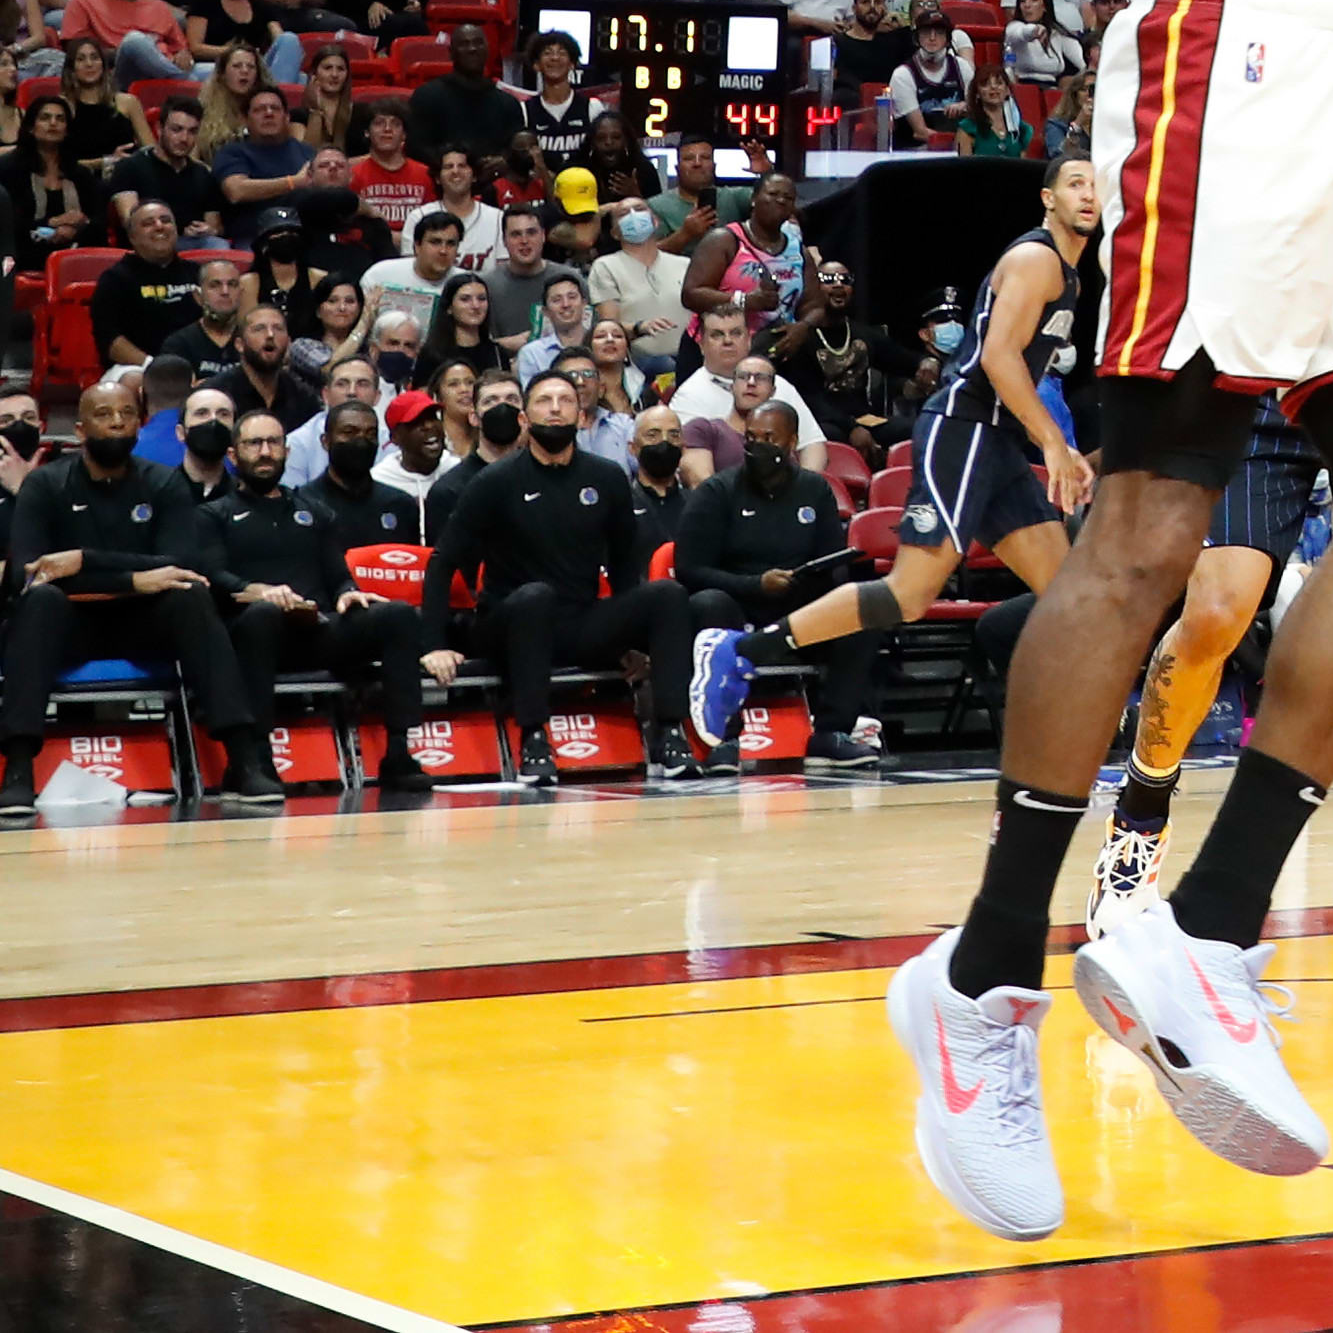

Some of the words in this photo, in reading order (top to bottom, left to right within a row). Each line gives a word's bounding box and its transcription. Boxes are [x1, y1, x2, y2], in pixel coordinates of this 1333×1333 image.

[718, 73, 764, 91] MAGIC
[645, 98, 668, 138] 2
[726, 104, 778, 136] 44
[549, 714, 596, 734] BIO
[70, 736, 123, 757] BIO
